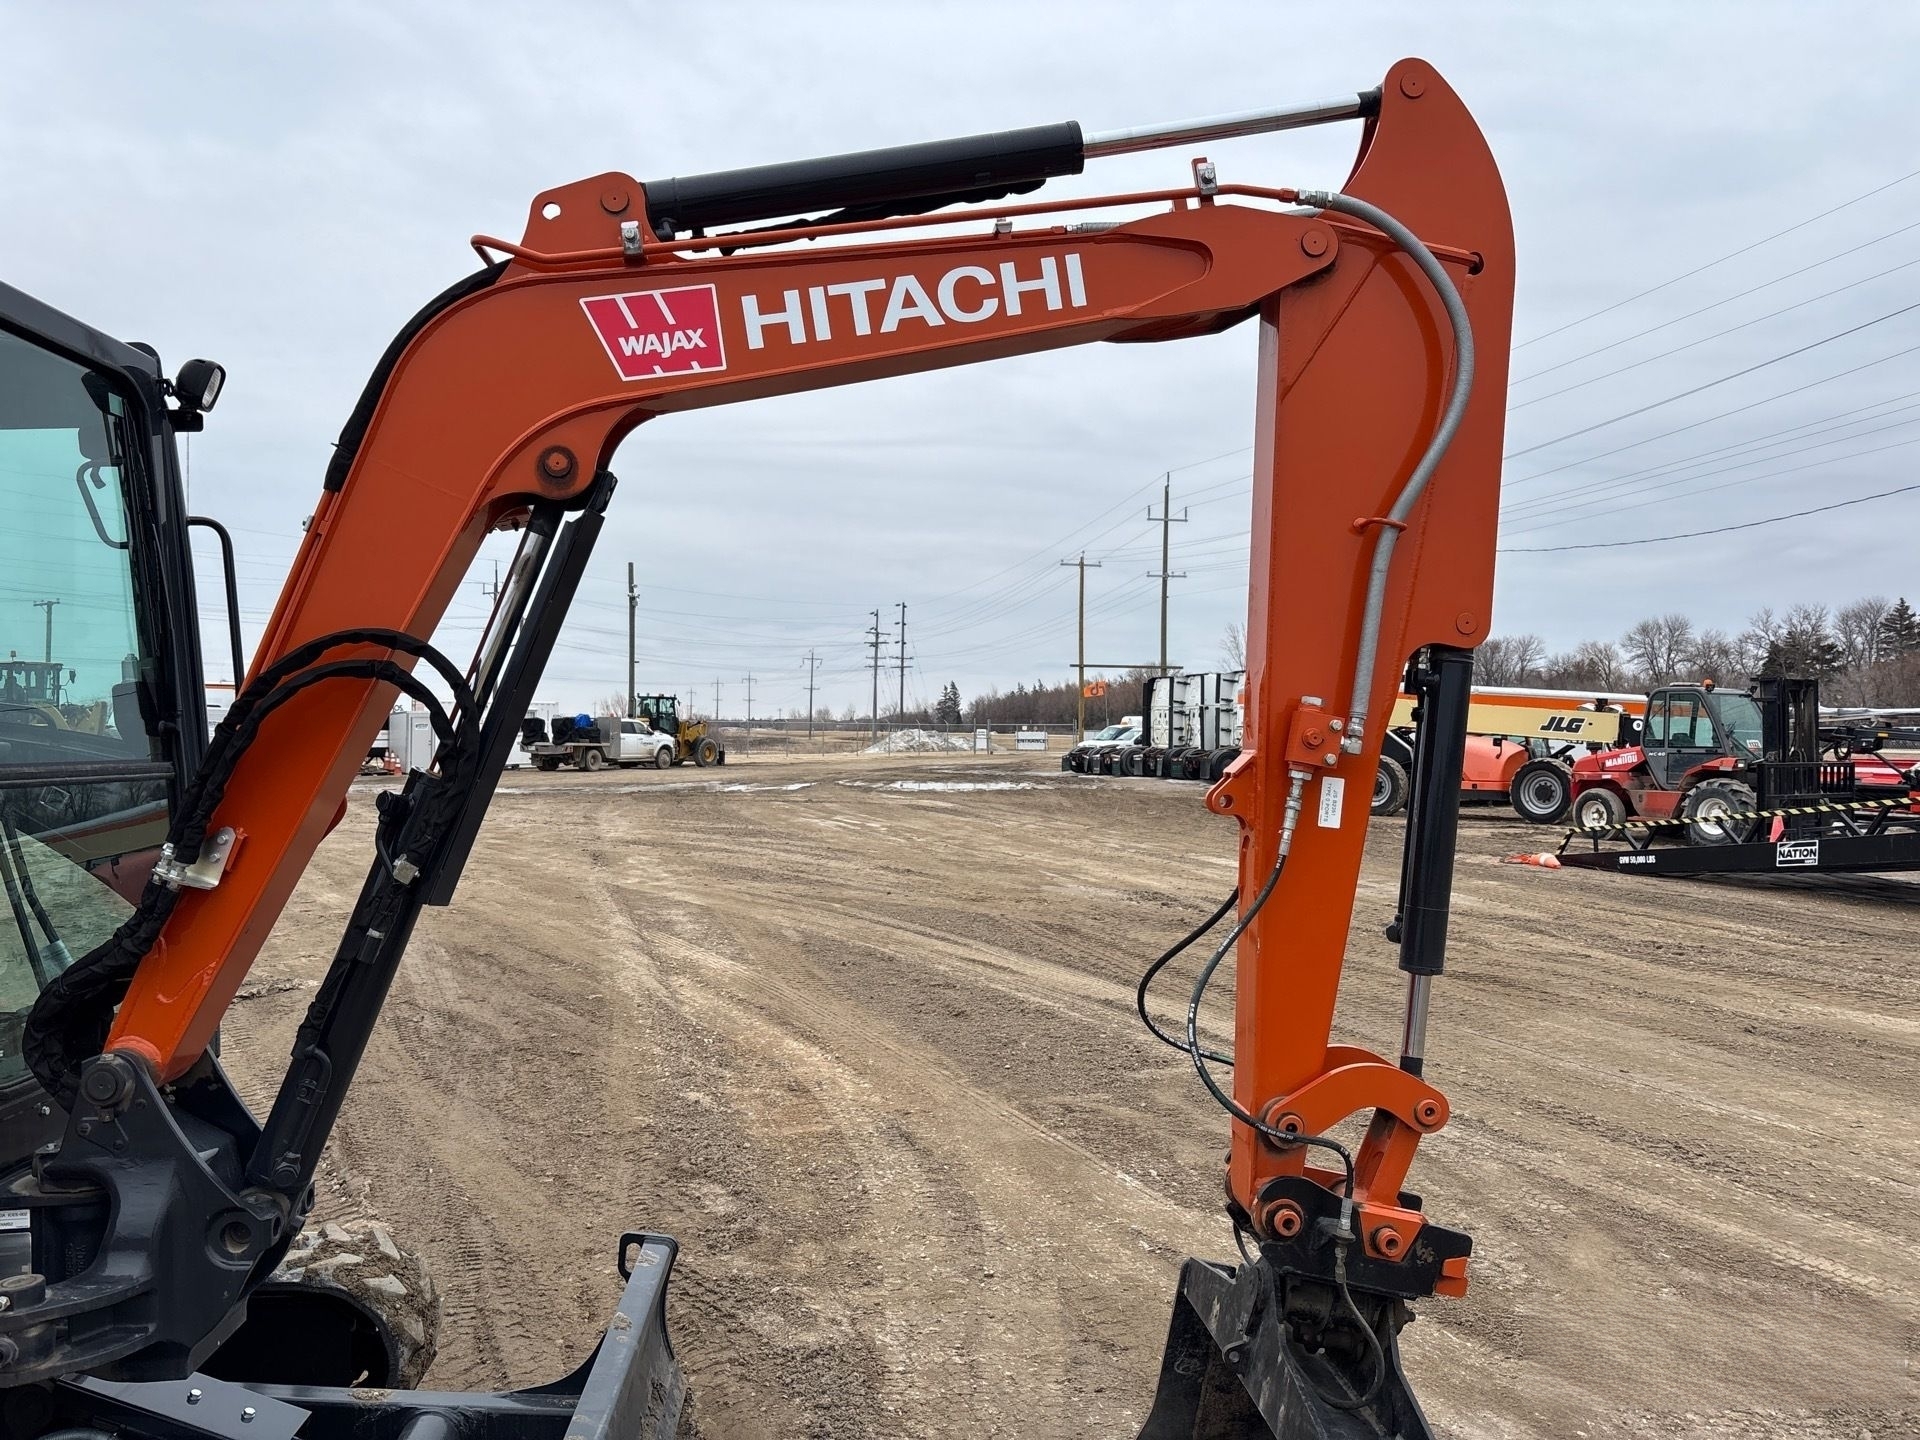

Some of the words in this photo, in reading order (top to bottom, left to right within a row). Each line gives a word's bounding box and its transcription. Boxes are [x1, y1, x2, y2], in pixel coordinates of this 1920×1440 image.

[741, 253, 1088, 350] HITACHI
[617, 328, 708, 358] WAJAX
[1540, 716, 1586, 734] JLG
[1605, 751, 1638, 768] MANITOU
[1646, 855, 1656, 864] LBS
[1778, 848, 1817, 859] NATION
